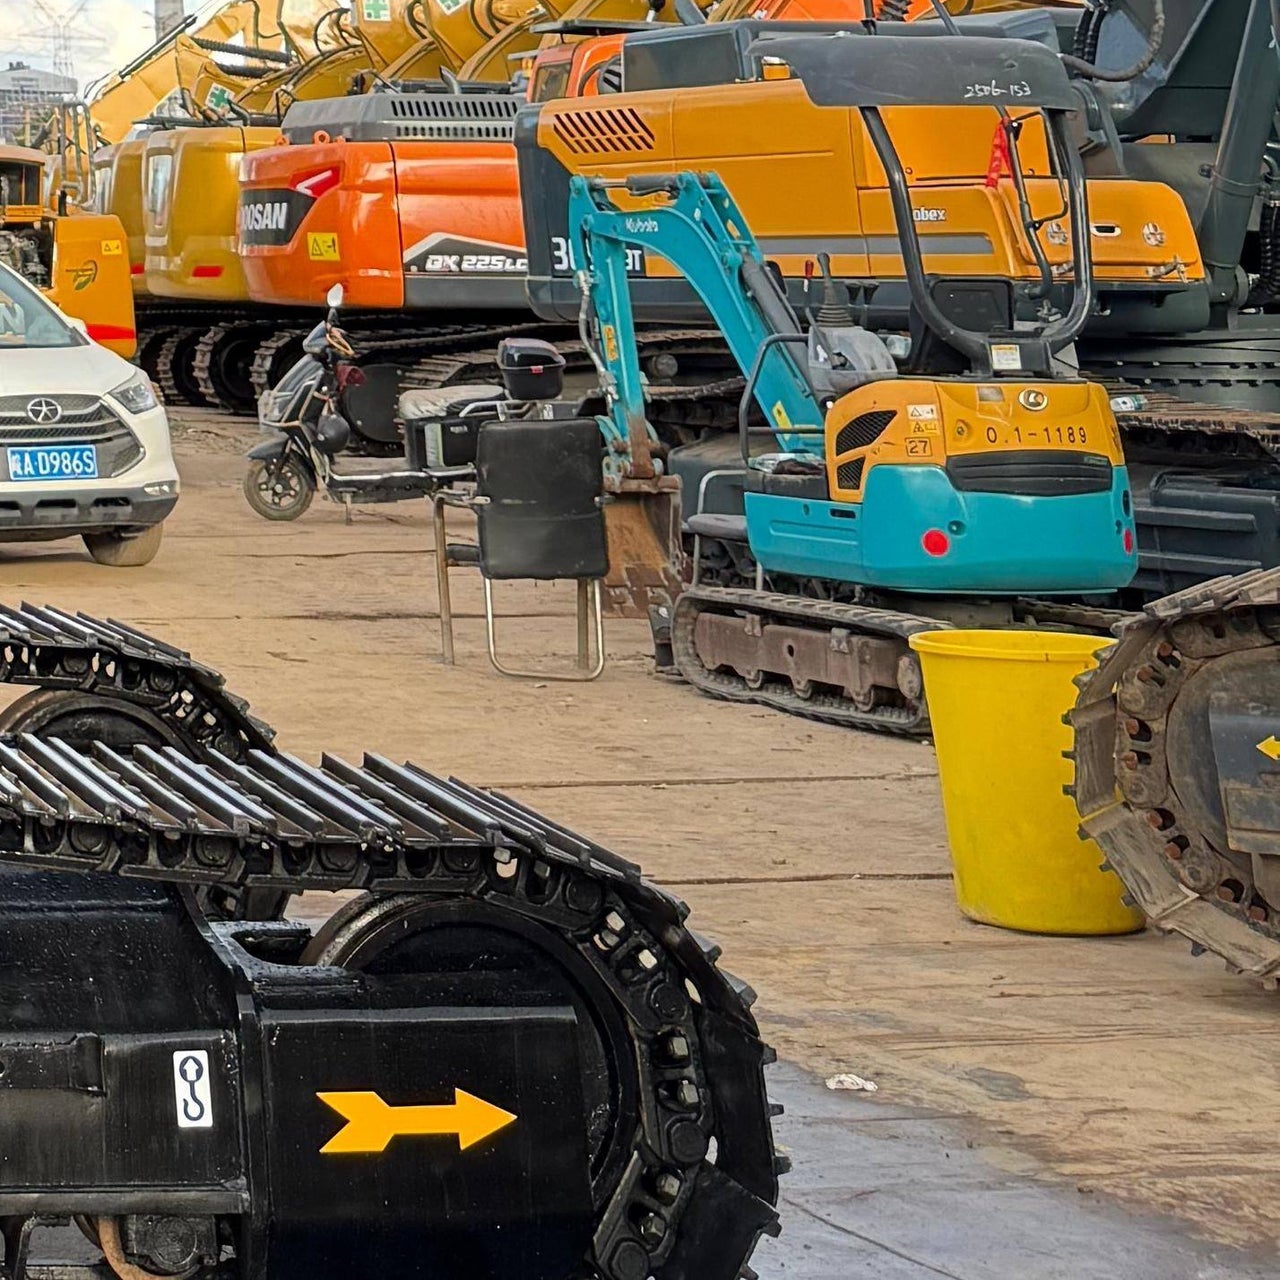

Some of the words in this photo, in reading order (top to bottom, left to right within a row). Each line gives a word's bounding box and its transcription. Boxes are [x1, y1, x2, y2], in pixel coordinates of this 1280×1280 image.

[964, 79, 1031, 98] 2506-153
[912, 206, 945, 221] obex
[908, 440, 929, 454] 27
